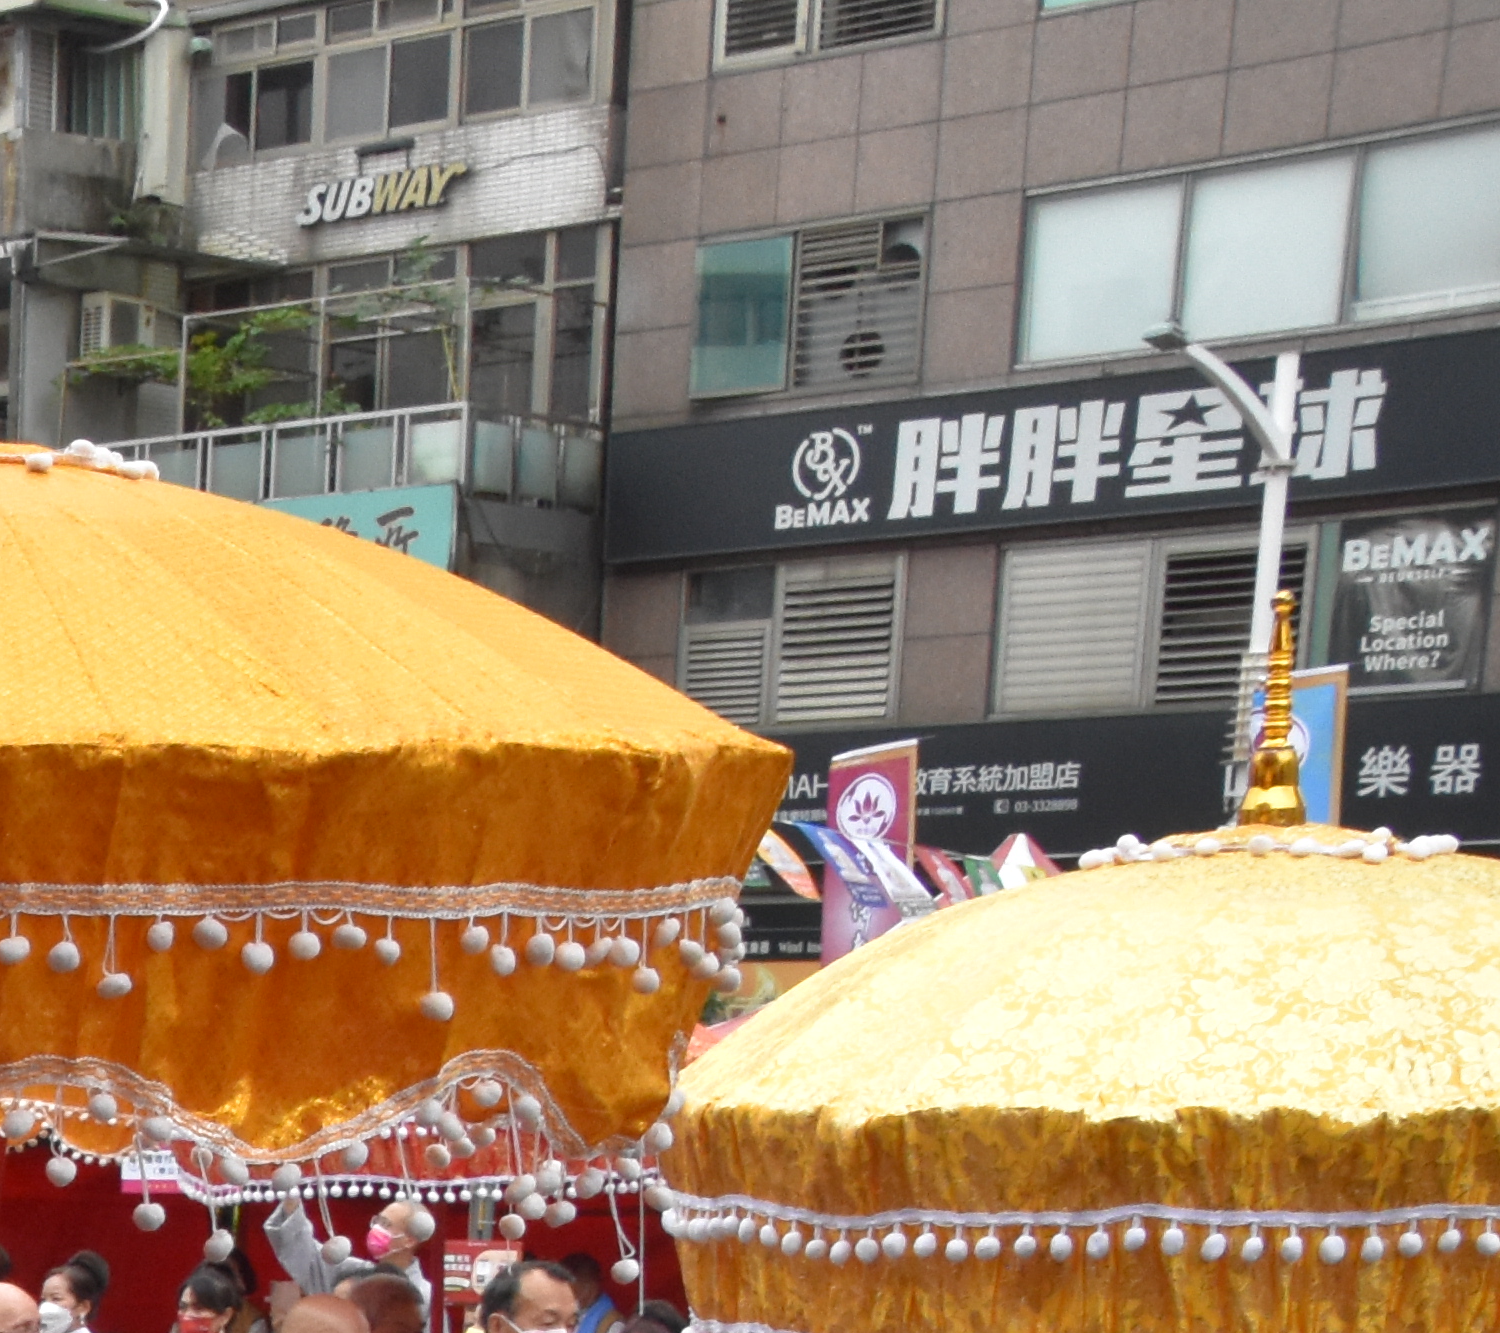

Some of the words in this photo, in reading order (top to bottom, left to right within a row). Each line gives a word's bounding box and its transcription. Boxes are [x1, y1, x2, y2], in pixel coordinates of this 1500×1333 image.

[296, 162, 468, 226] SUBWAY
[887, 369, 1387, 520] 胖胖星球
[1369, 608, 1444, 635] Special
[1360, 631, 1448, 652] Location
[1364, 651, 1441, 673] Where?
